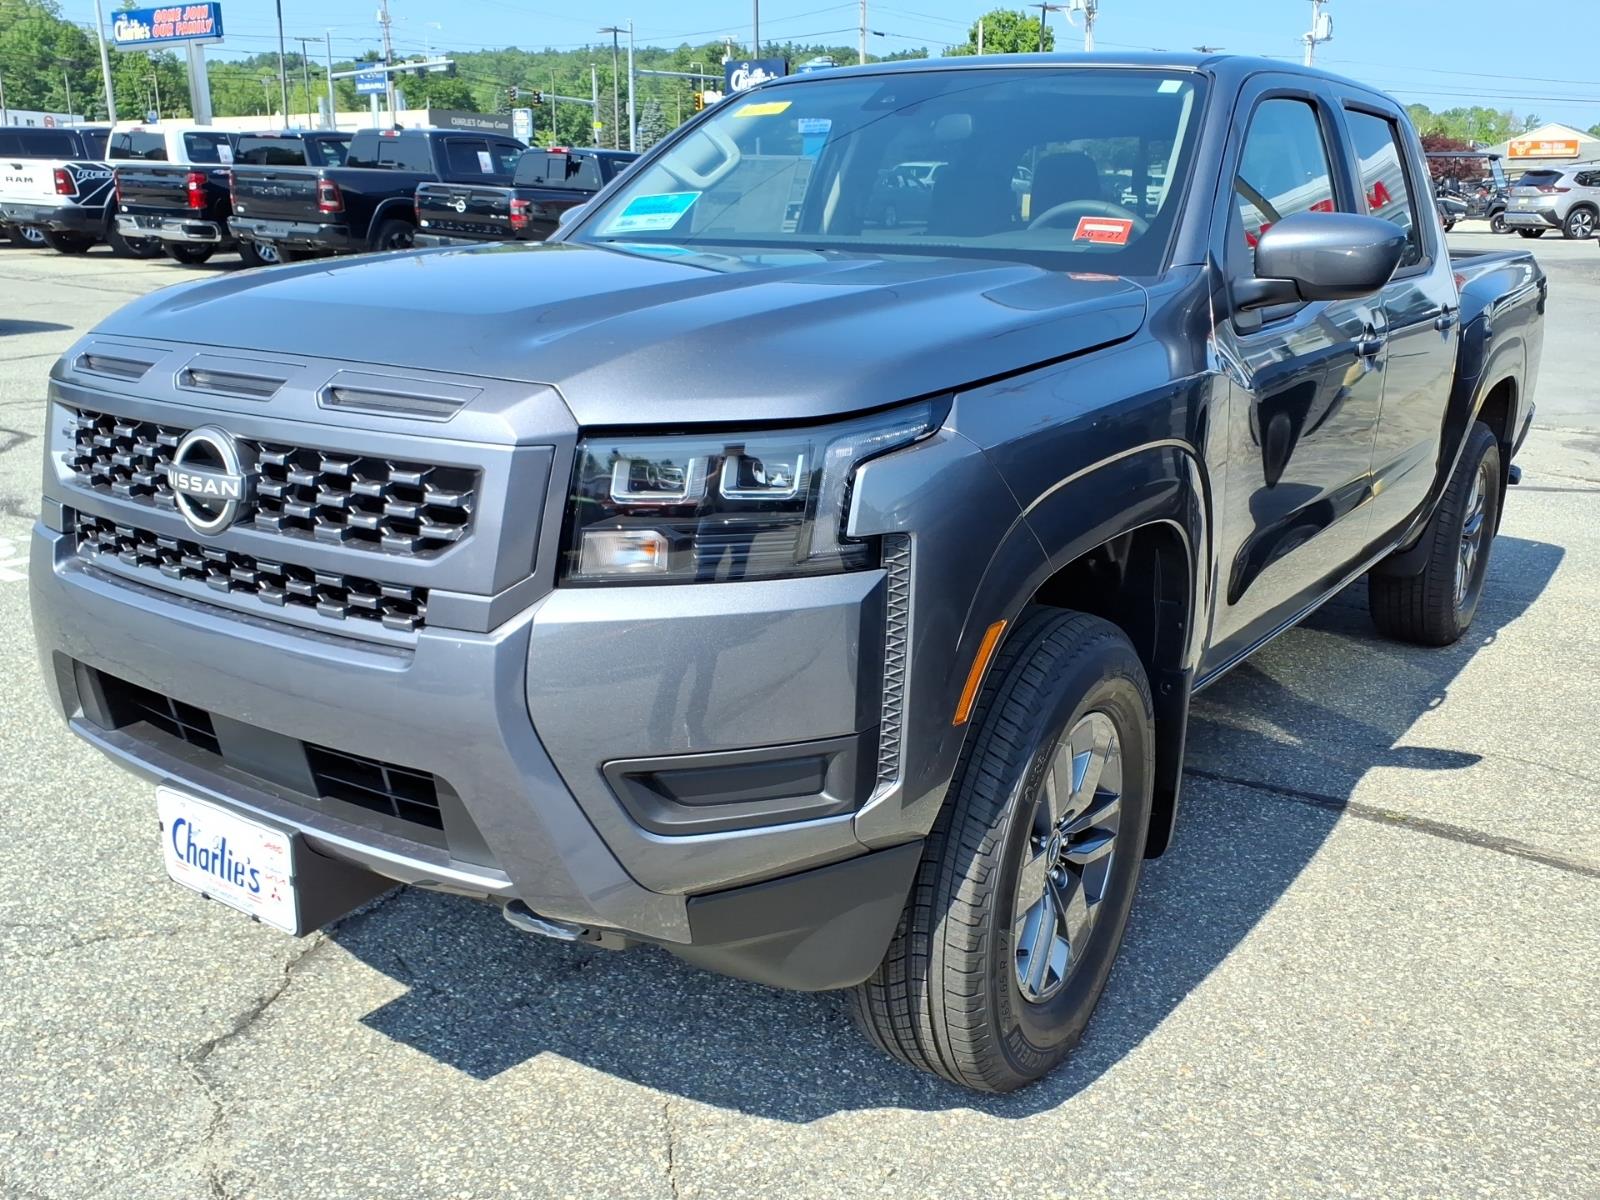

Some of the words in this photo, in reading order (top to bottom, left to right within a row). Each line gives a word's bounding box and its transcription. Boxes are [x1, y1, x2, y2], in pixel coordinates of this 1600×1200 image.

[154, 8, 182, 23] COME
[184, 5, 208, 20] JOIN
[114, 19, 150, 41] Charlie's
[152, 22, 173, 37] OUR
[176, 18, 213, 36] FAMILY
[357, 82, 385, 90] SUBARU
[731, 68, 779, 91] Charlie'
[253, 186, 292, 197] RAM
[1107, 231, 1122, 239] 27
[167, 469, 239, 497] NISSAN
[172, 817, 261, 894] Charlie's
